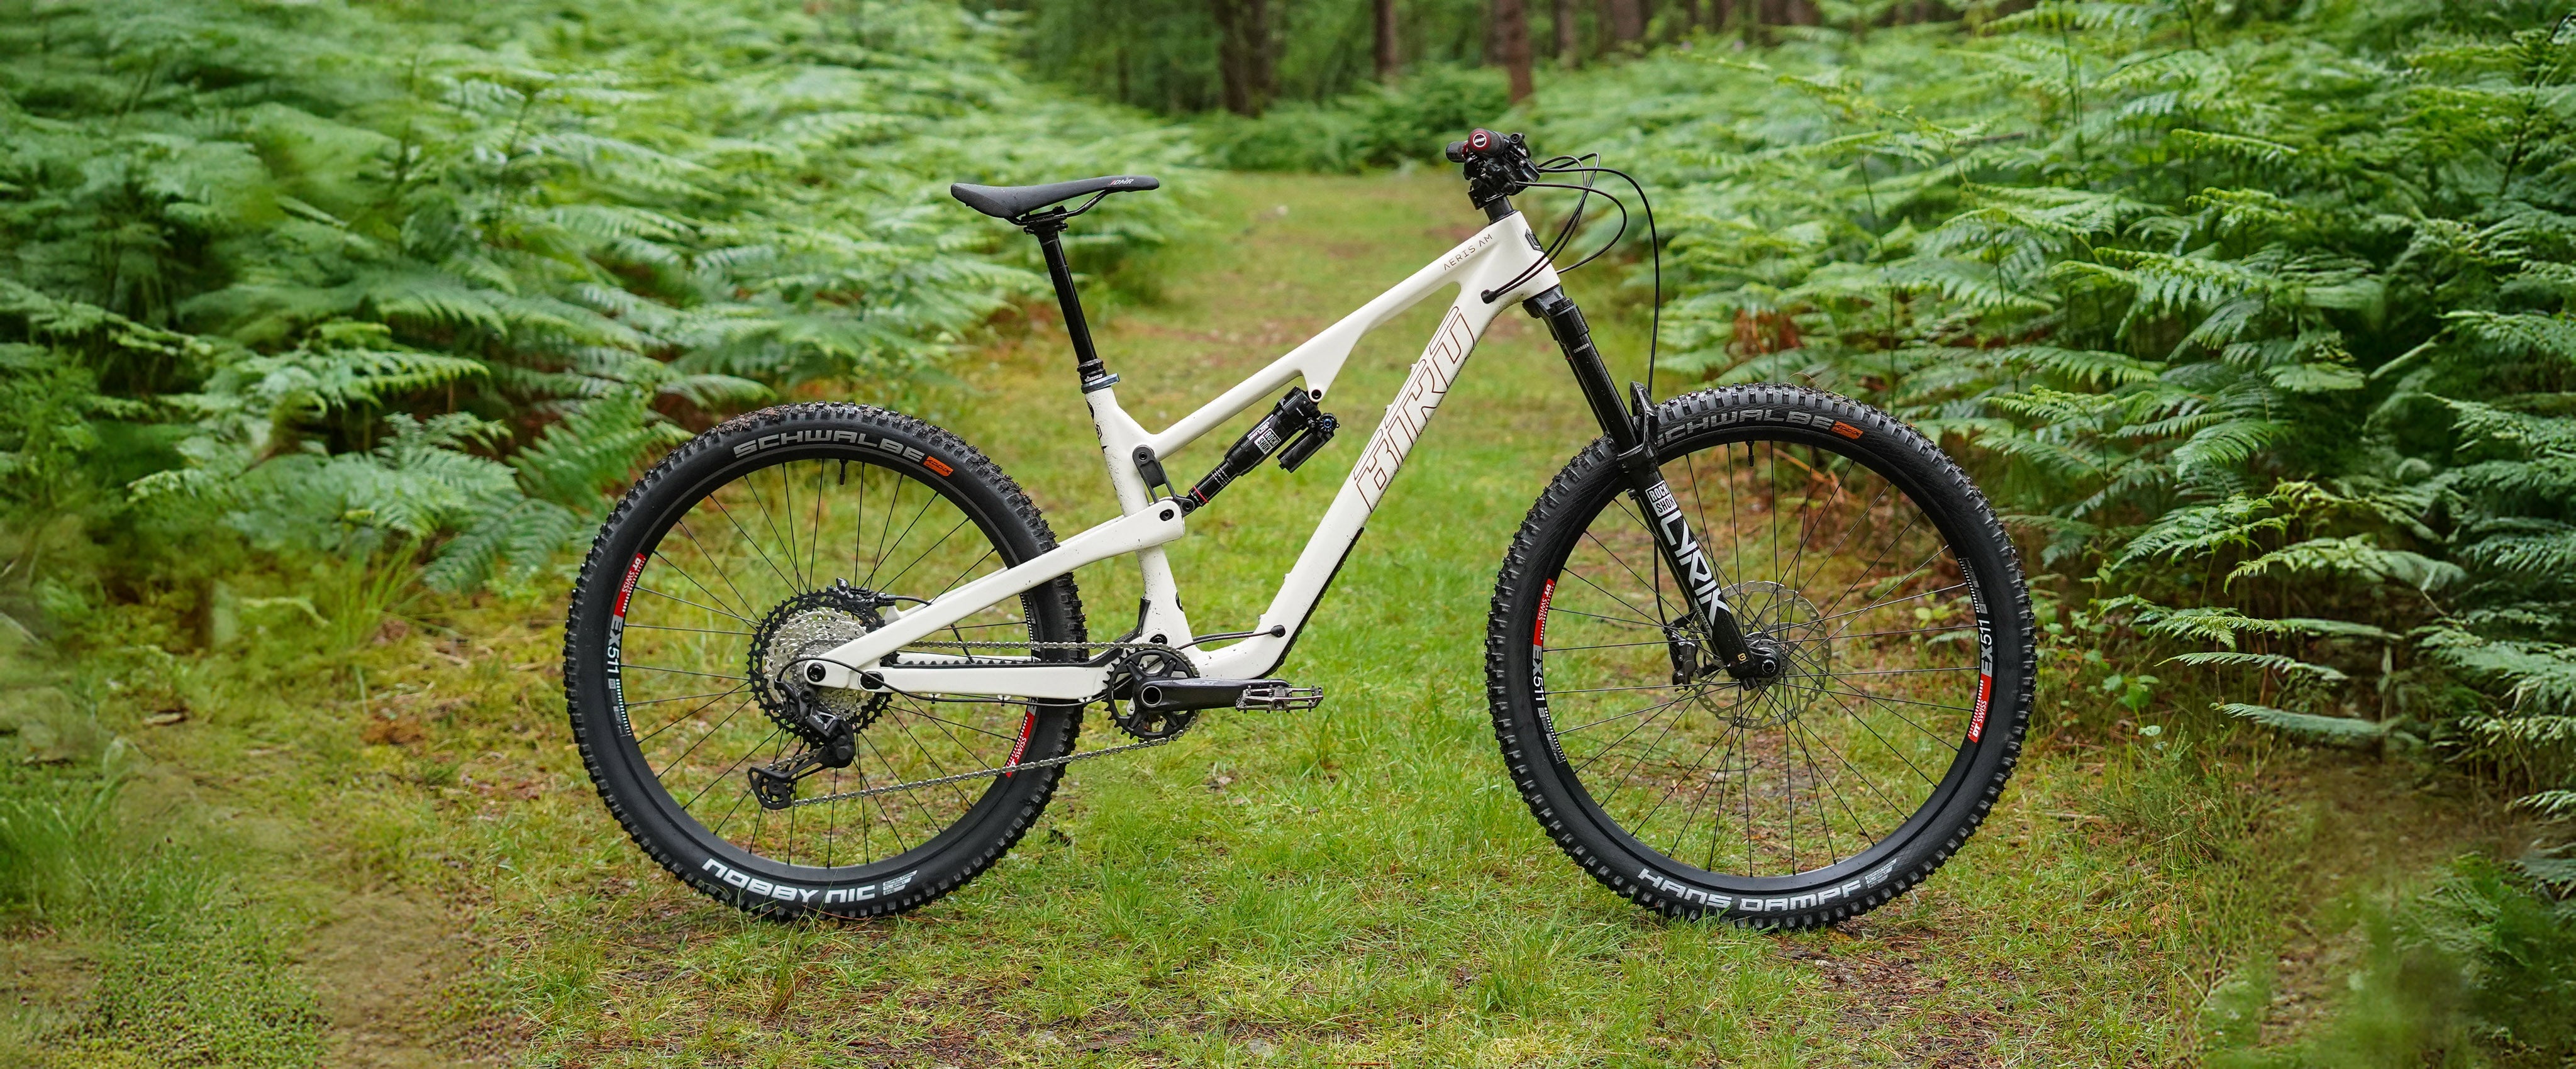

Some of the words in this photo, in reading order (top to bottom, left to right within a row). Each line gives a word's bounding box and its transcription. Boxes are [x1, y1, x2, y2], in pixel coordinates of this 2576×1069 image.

[1113, 177, 1135, 186] DMR
[1443, 245, 1475, 270] AERIS
[1479, 233, 1493, 247] AM
[1353, 306, 1475, 512] BIRD
[733, 429, 925, 458] SCHWALBE
[1257, 438, 1272, 453] SHOX
[1264, 431, 1279, 447] ROCK
[1648, 483, 1669, 502] ROCK
[1656, 496, 1675, 513] SHOX
[633, 557, 640, 570] DT
[1660, 509, 1731, 627] LYRIK
[622, 570, 635, 593] SWISS
[1545, 584, 1552, 597] DT
[1538, 598, 1547, 621] SWISS
[607, 614, 623, 674] EX511
[1978, 619, 1993, 678] EX511
[1533, 645, 1546, 701] EX511
[1975, 699, 1987, 723] SWISS
[1972, 723, 1980, 738] DT
[1014, 736, 1027, 760] SWISS
[701, 858, 819, 903] NOBBY
[824, 885, 875, 904] NIC
[1638, 868, 1732, 909] HANS
[1739, 880, 1861, 912] DAMPF
